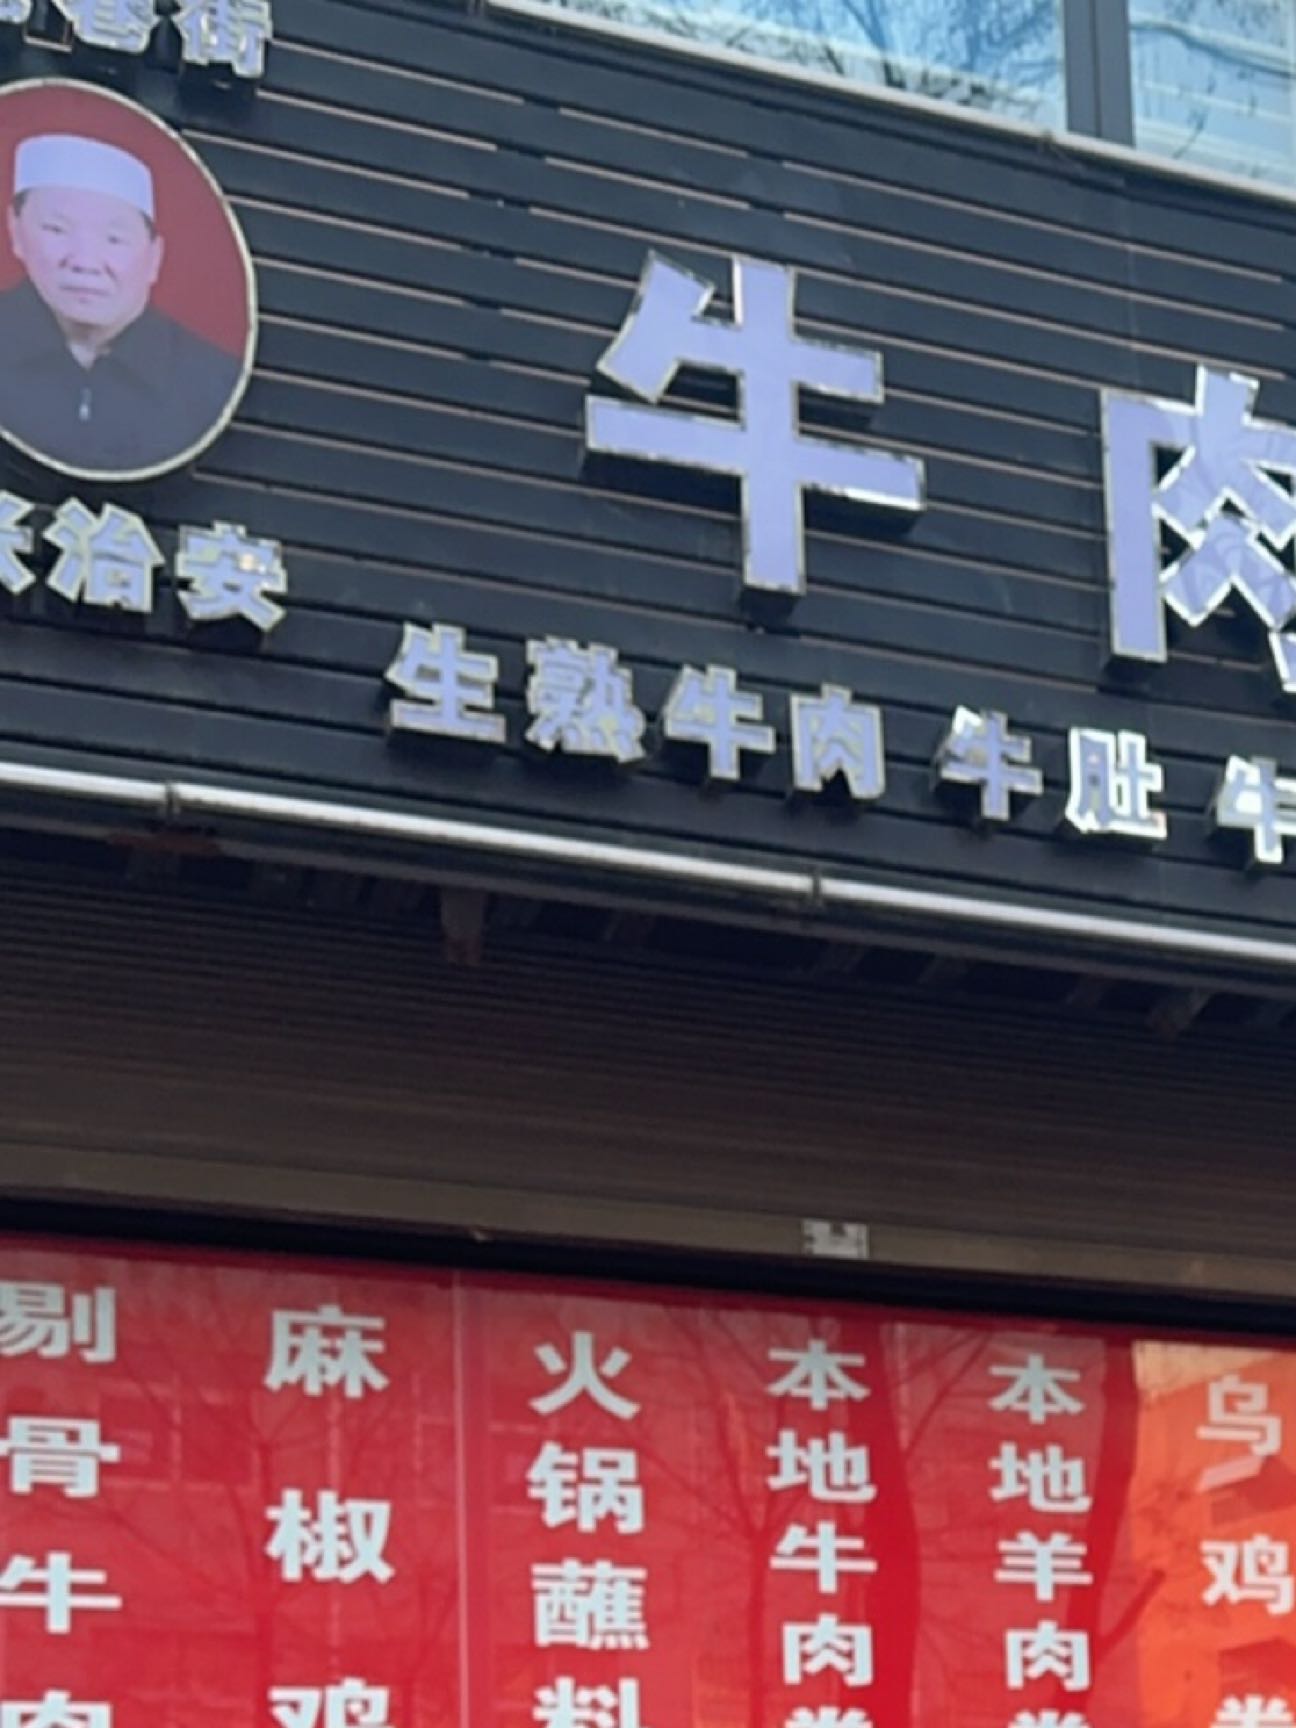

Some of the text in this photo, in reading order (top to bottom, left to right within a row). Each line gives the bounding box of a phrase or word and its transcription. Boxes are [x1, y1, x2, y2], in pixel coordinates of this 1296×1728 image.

[387, 622, 886, 800] 生熟牛肉
[937, 705, 1167, 840] 牛肚
